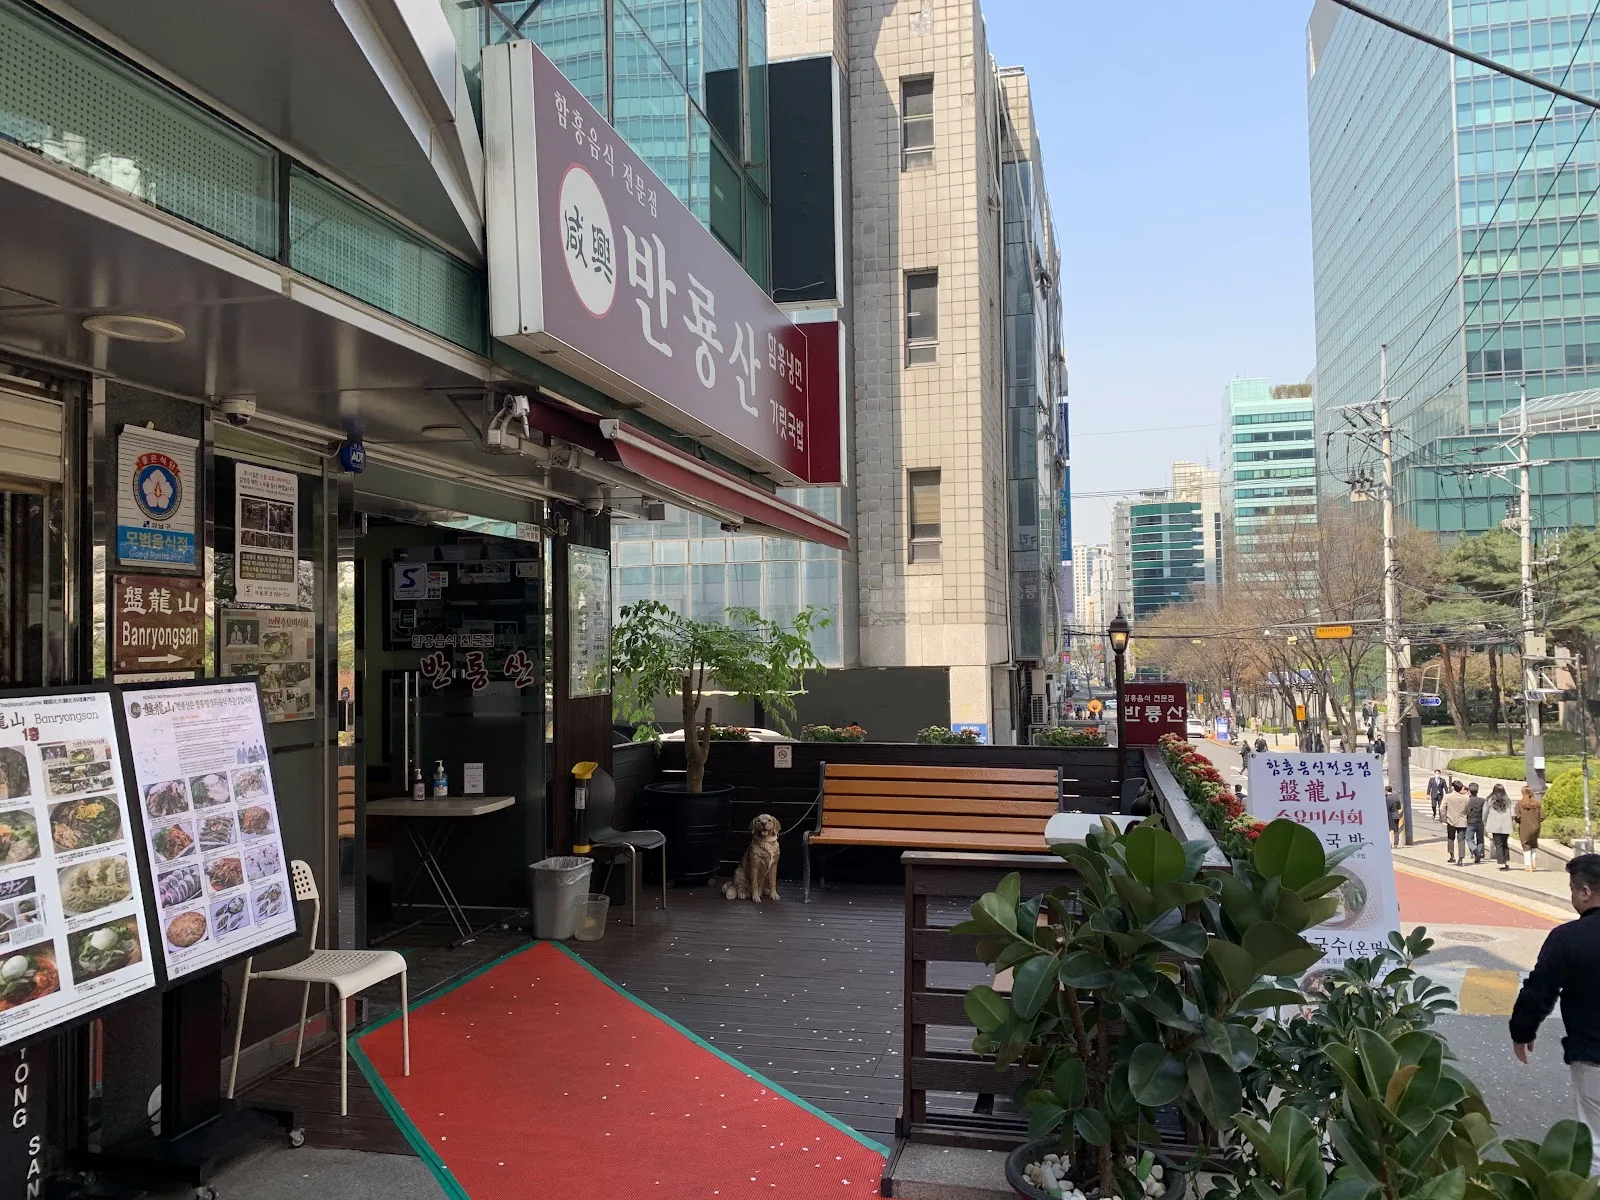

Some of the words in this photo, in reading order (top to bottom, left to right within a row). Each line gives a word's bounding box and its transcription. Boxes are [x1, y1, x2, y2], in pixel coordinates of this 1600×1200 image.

[554, 91, 615, 178] 함흥음식
[621, 164, 658, 219] 전문점
[564, 205, 612, 284] 咸興
[622, 225, 762, 418] 반룡산
[768, 332, 802, 392] 함흥냉면
[126, 531, 188, 552] 모범음식점
[122, 586, 199, 614] 盤龍山
[122, 621, 199, 650] Banryongsan
[411, 633, 457, 648] 함흥음식
[459, 633, 494, 648] 전문점
[420, 650, 534, 689] 반룡산
[1153, 694, 1175, 703] 전문점
[34, 711, 99, 725] Banryongsan
[1124, 705, 1185, 723] 반룡산
[1279, 779, 1356, 802] 盤龍山
[27, 1135, 40, 1200] SAN
